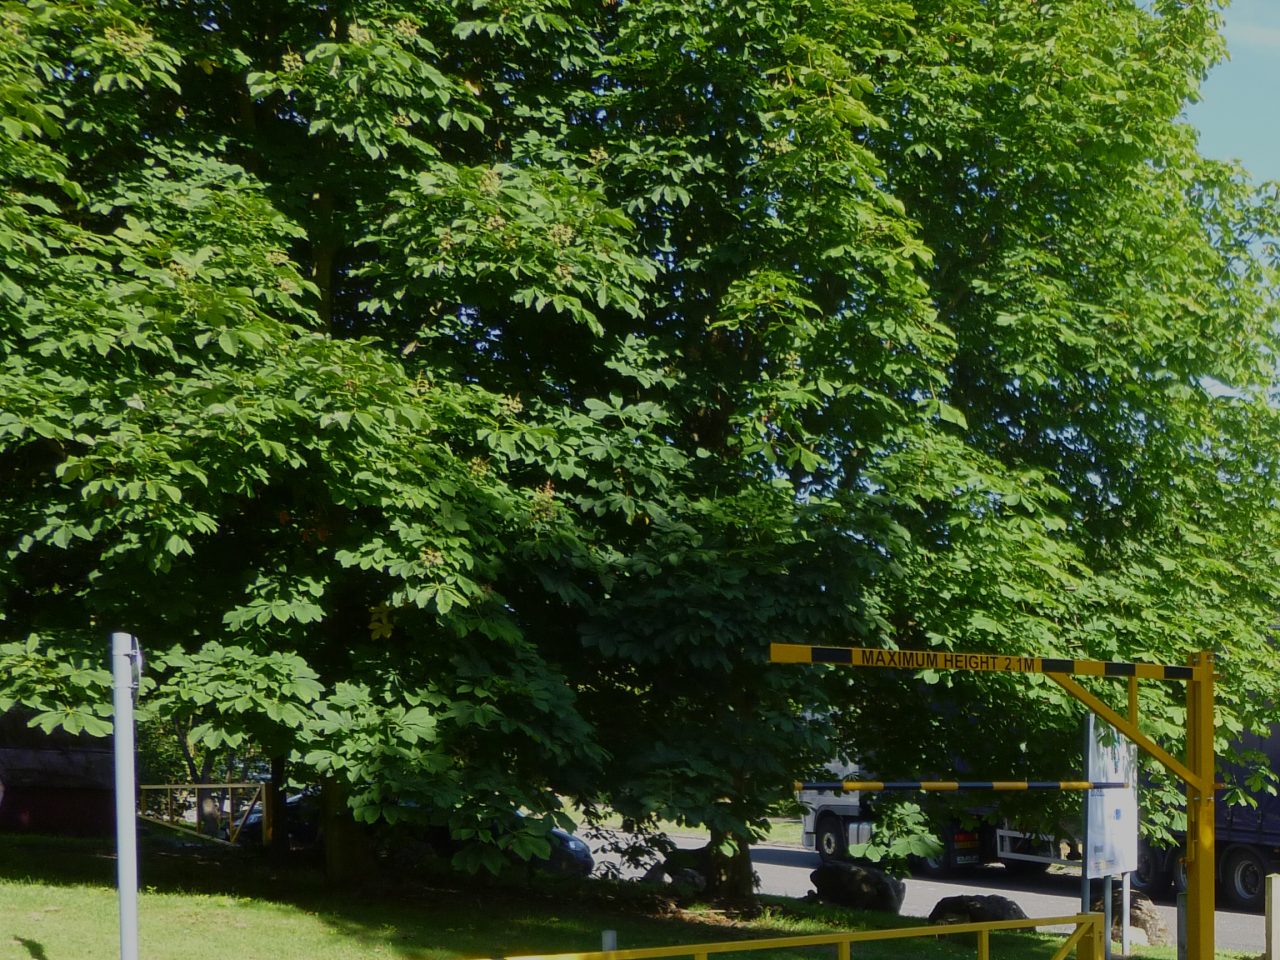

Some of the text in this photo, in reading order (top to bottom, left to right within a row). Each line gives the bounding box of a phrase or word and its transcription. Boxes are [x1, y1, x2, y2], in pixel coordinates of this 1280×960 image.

[862, 649, 1035, 672] MAXIMUM HEIGHT 2.1M
